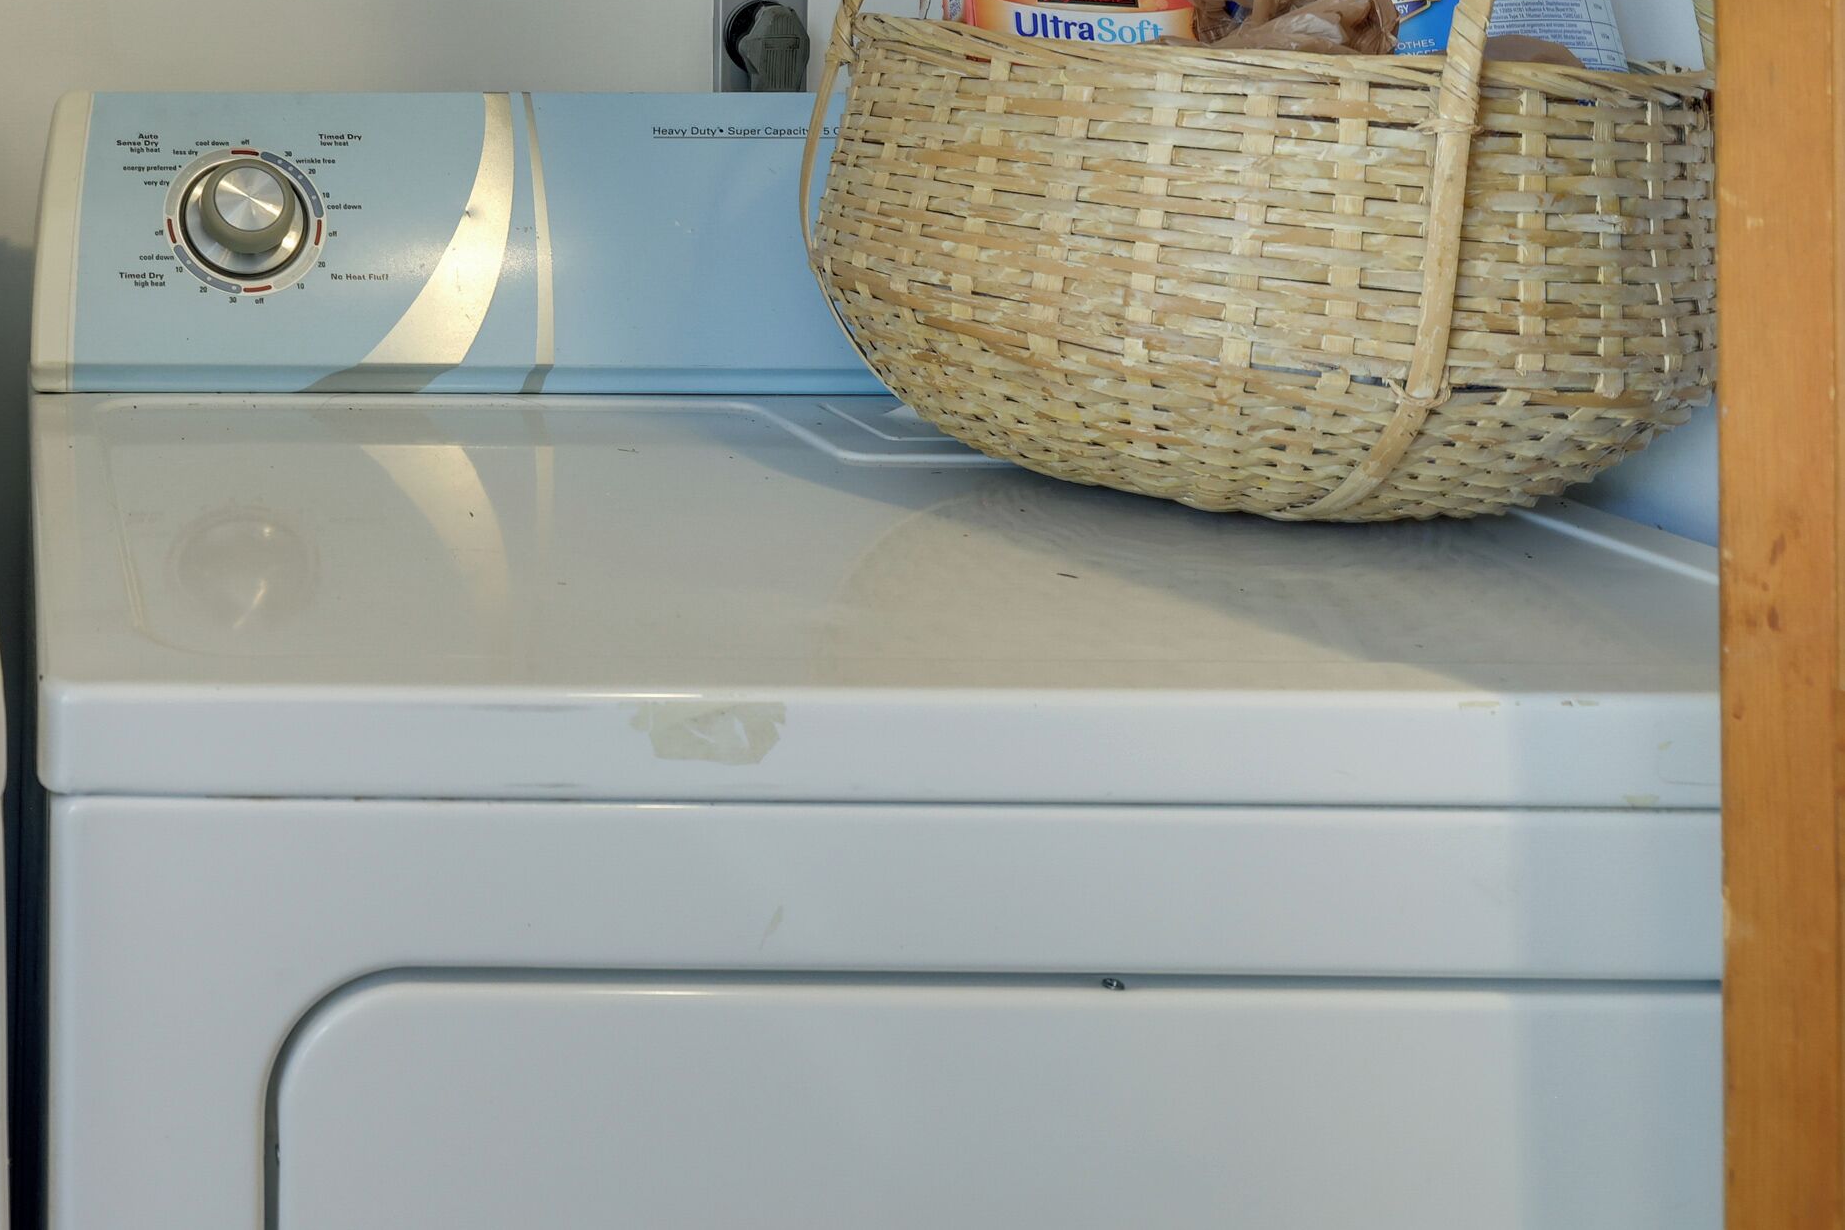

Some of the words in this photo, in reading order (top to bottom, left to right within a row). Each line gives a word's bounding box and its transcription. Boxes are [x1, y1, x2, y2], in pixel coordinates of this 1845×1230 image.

[1396, 38, 1435, 50] OTHES
[652, 126, 688, 137] Heavy
[727, 126, 761, 137] Super
[823, 127, 830, 136] 5
[347, 133, 362, 141] Dry
[144, 140, 159, 148] Dry
[188, 149, 198, 157] dry
[146, 164, 177, 172] preferred
[159, 179, 170, 187] dry
[149, 272, 164, 280] Dry
[134, 280, 149, 288] high
